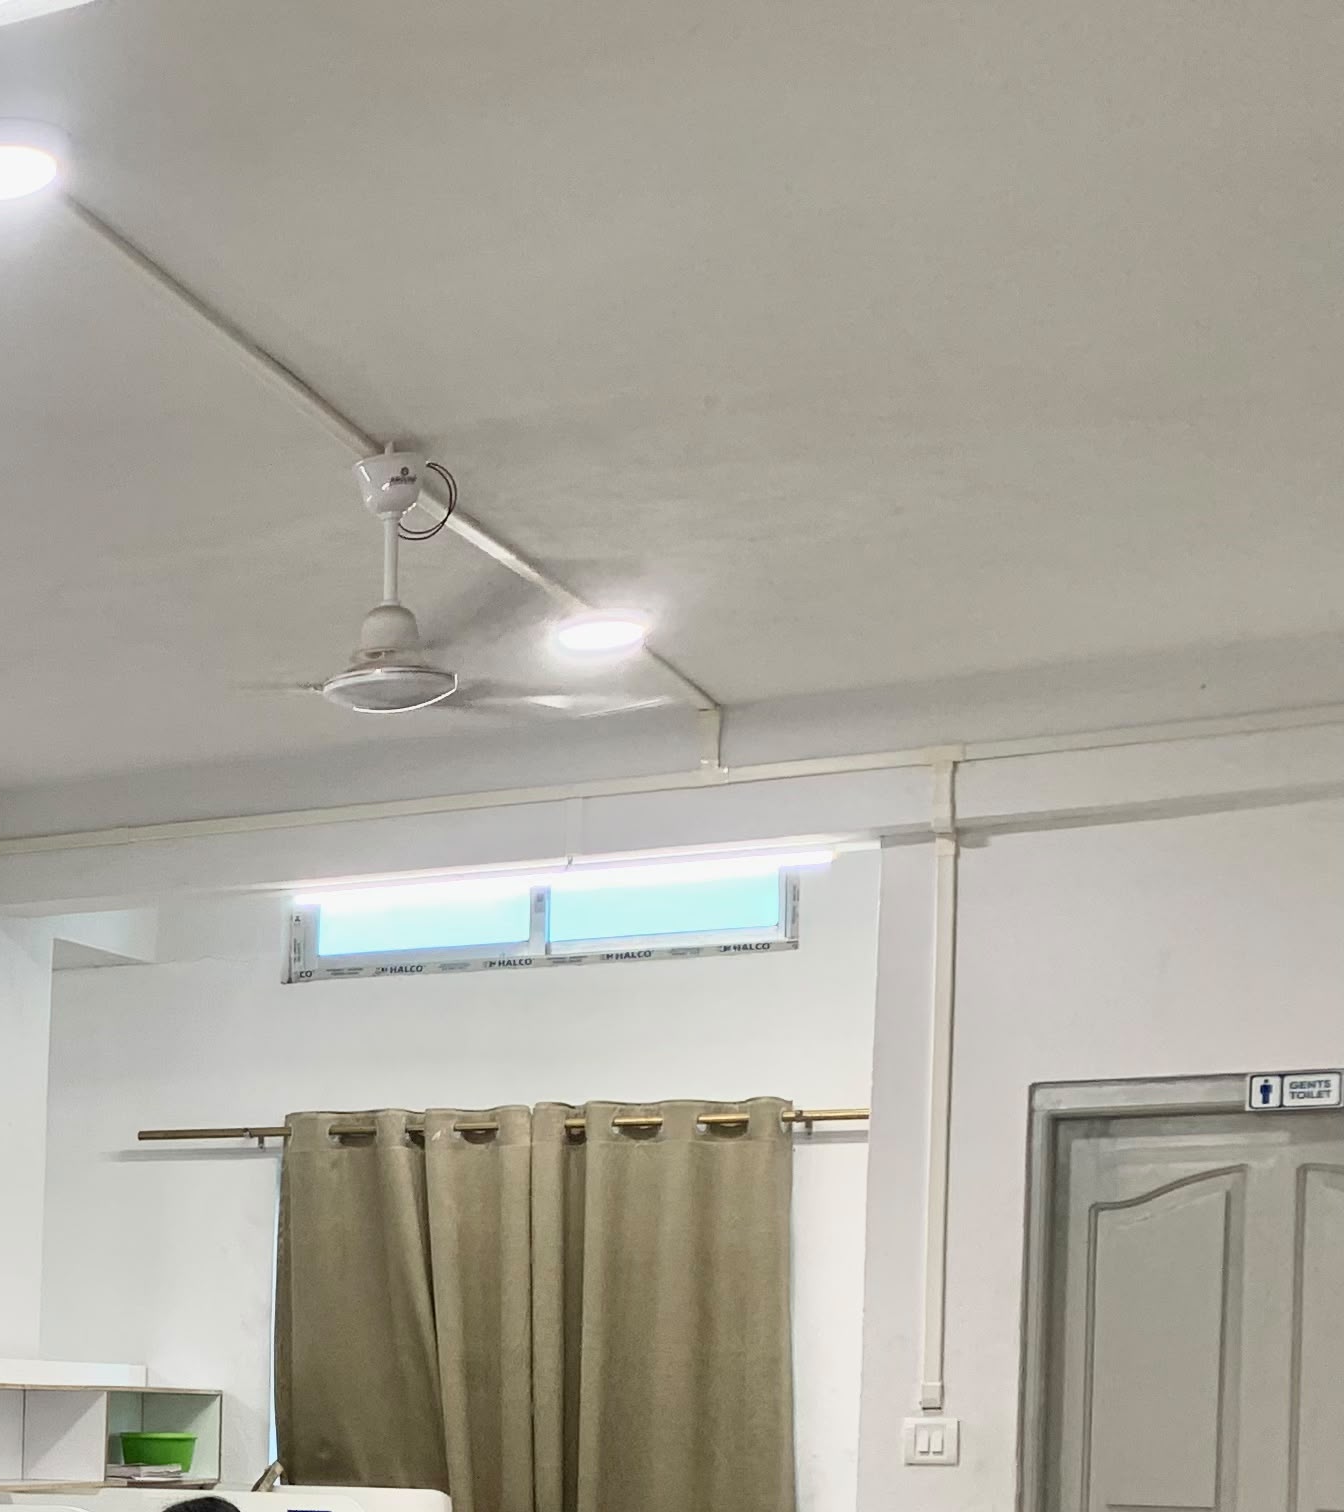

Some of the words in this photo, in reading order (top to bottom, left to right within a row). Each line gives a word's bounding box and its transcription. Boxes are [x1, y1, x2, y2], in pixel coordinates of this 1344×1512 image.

[615, 950, 653, 961] HALCO
[498, 958, 533, 966] HALCO
[390, 965, 424, 974] HALCO
[1289, 1080, 1331, 1090] GENTS
[1289, 1090, 1332, 1099] TOILET
